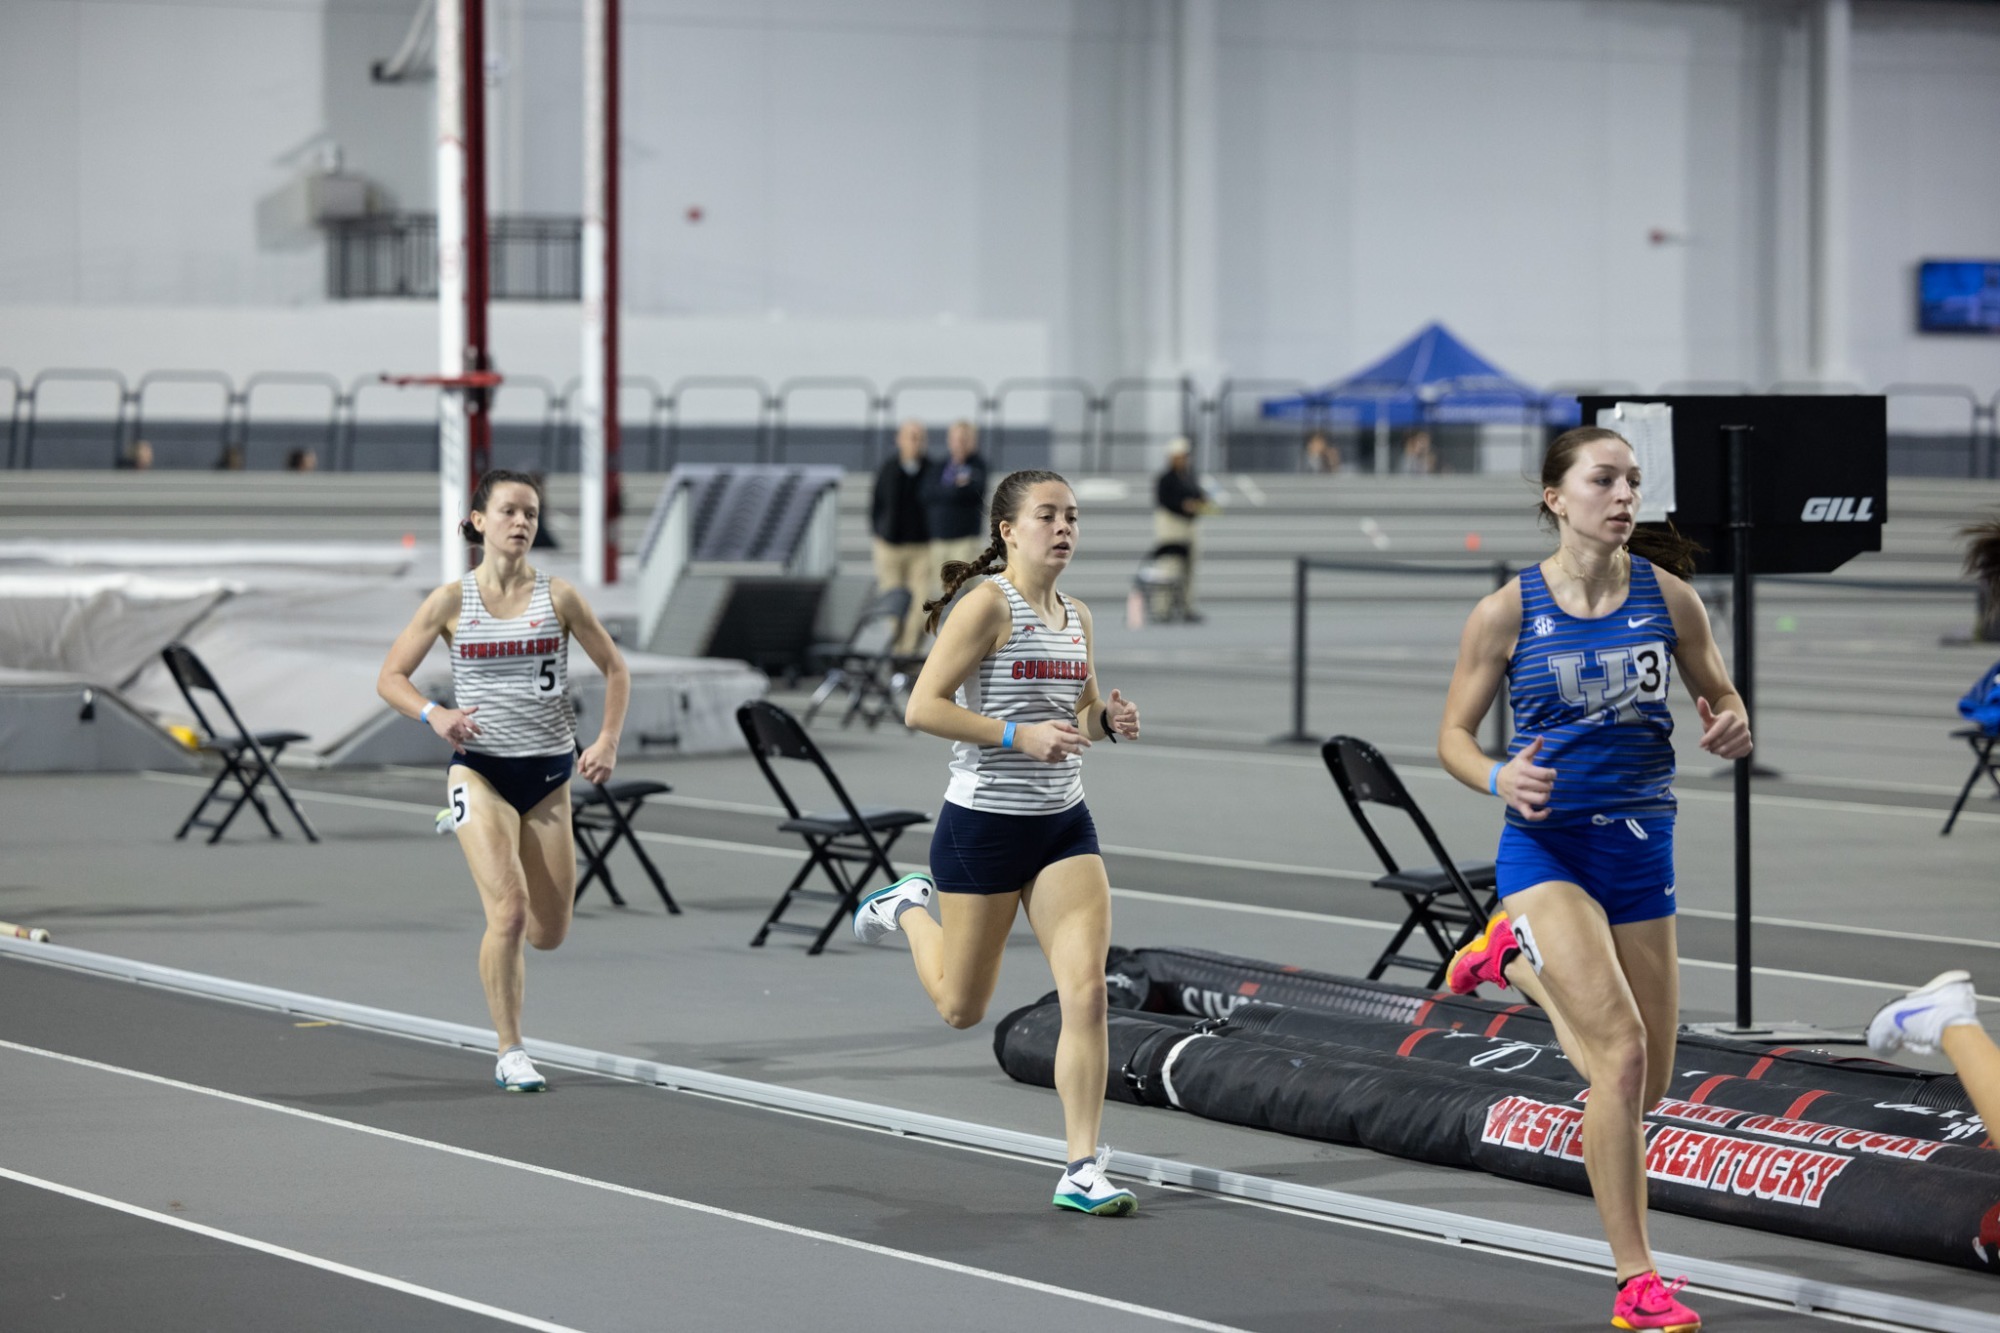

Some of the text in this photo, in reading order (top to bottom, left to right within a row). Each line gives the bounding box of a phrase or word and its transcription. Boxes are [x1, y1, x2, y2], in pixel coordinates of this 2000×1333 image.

[1801, 497, 1873, 522] GILL
[1533, 616, 1555, 636] SEC
[460, 636, 560, 659] CUMBERLANDS
[540, 659, 556, 691] 5
[1012, 660, 1088, 680] CUMBERLAN
[1637, 650, 1660, 693] 3
[453, 787, 465, 822] 5
[1481, 1096, 1855, 1208] WESTE KENTUCKY
